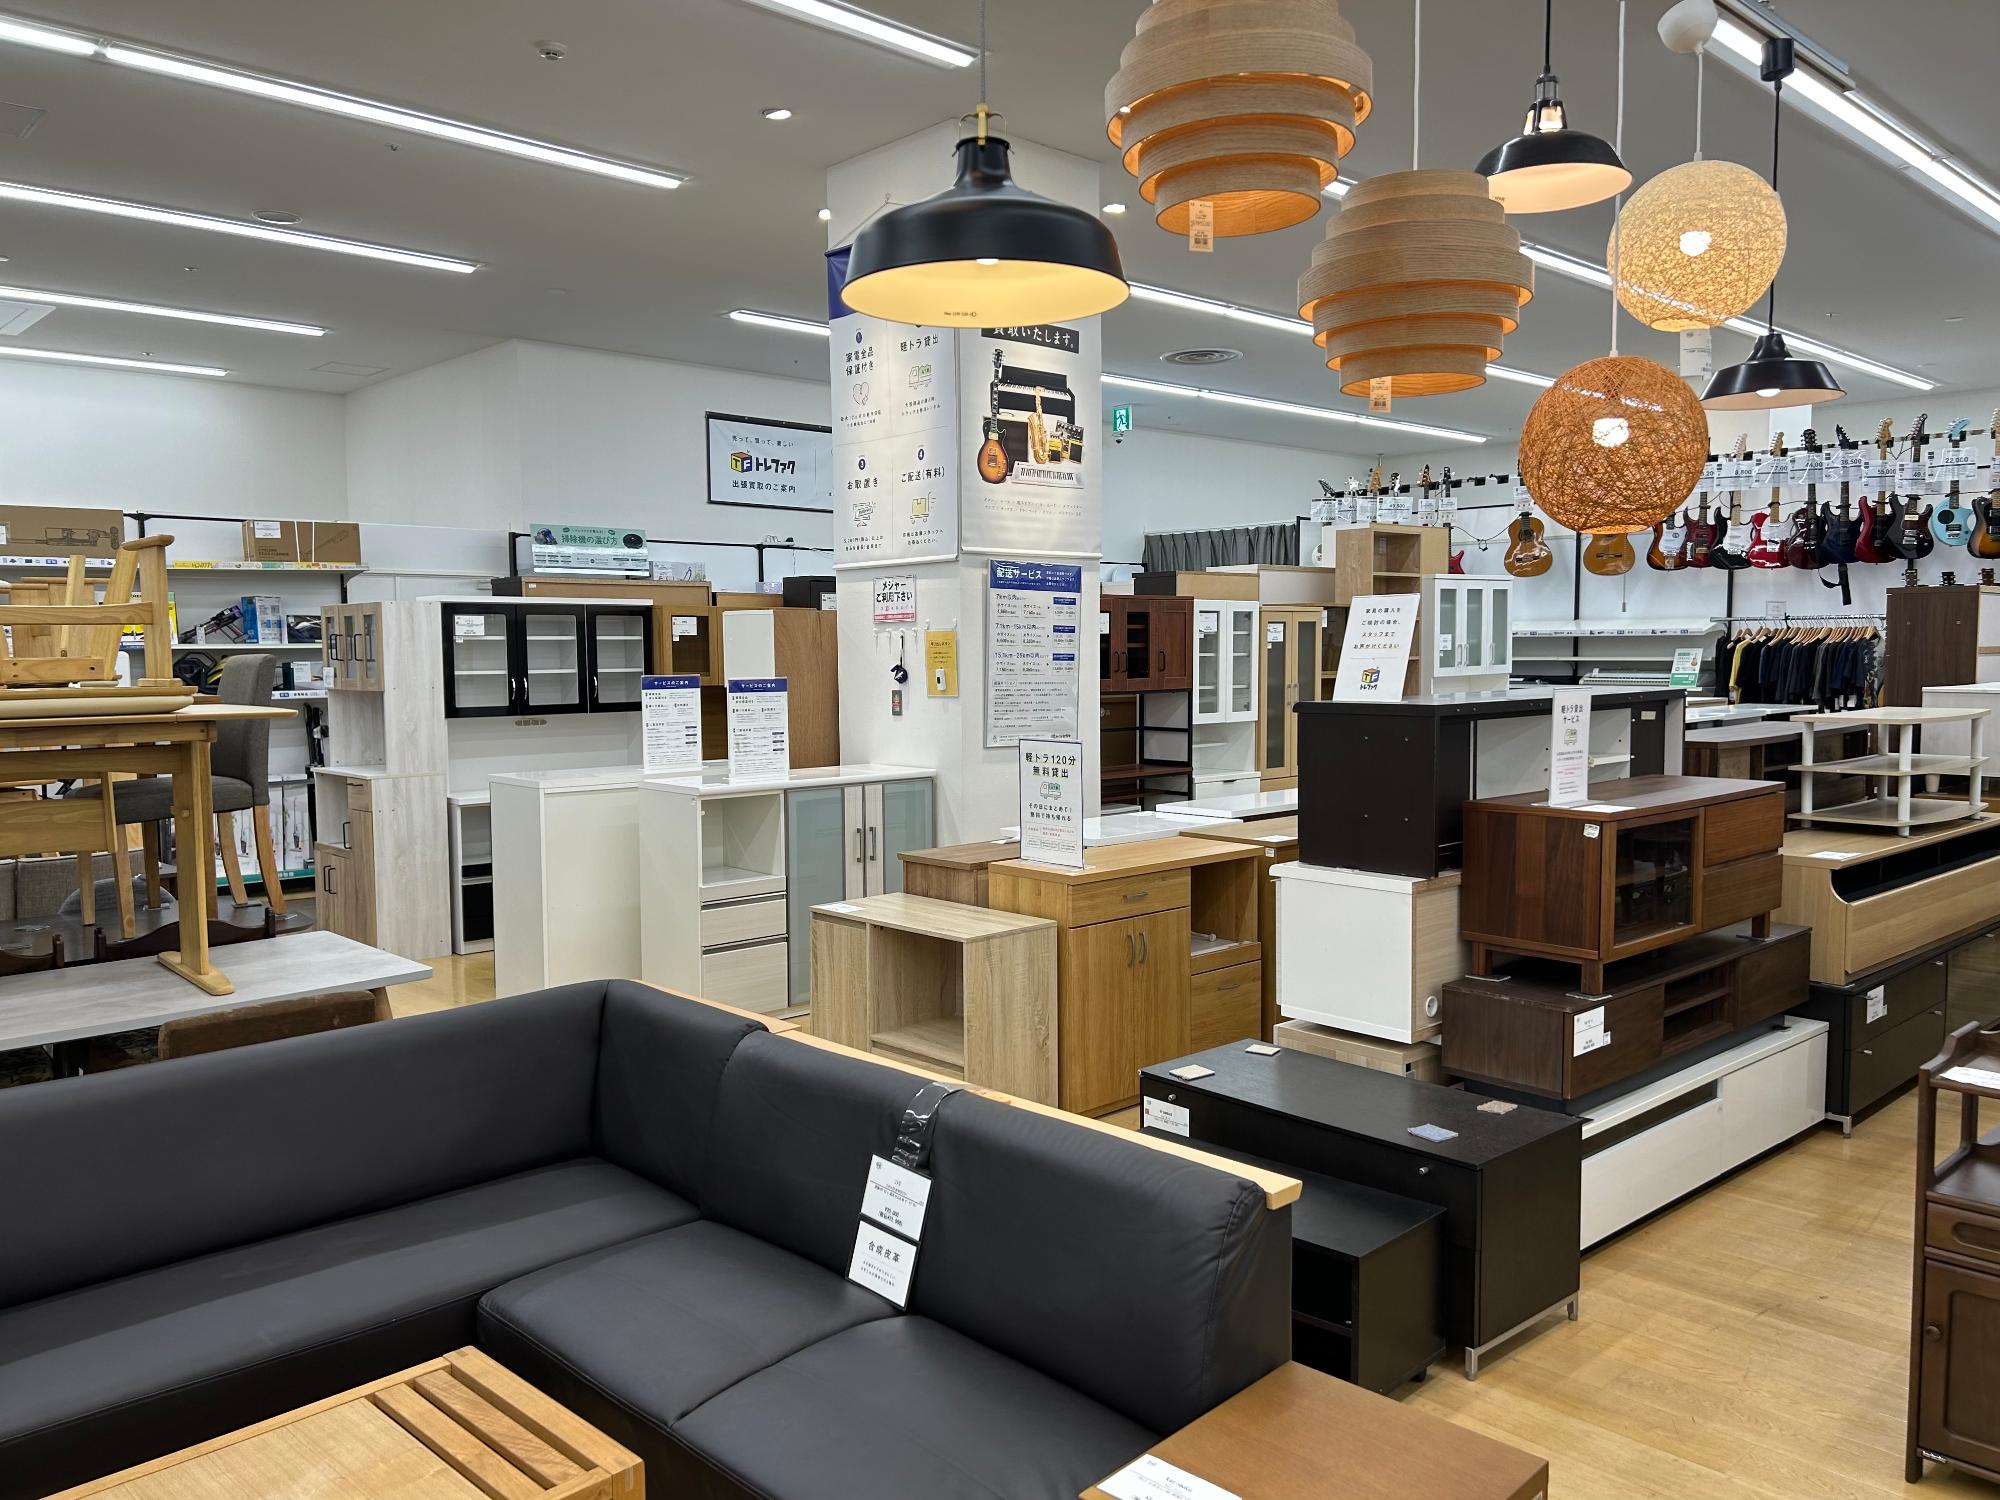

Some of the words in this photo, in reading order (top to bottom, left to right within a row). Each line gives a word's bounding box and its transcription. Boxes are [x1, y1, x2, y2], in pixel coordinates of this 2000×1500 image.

[900, 334, 939, 352] 軽トラ貸出
[845, 346, 875, 363] 家電全品
[845, 361, 875, 376] 保証付き
[755, 456, 796, 475] トレファク
[1945, 456, 1969, 465] 22,000
[732, 479, 796, 494] 出張買取のご案内
[847, 477, 878, 490] お取置き
[561, 534, 618, 546] 掃除機の選び方
[996, 566, 1042, 579] 配送サービス
[876, 591, 913, 603] ご利用下さい
[1025, 752, 1076, 765] 軽トラ120分
[1032, 766, 1069, 779] 無料貸出
[868, 1240, 901, 1263] 合成皮革
